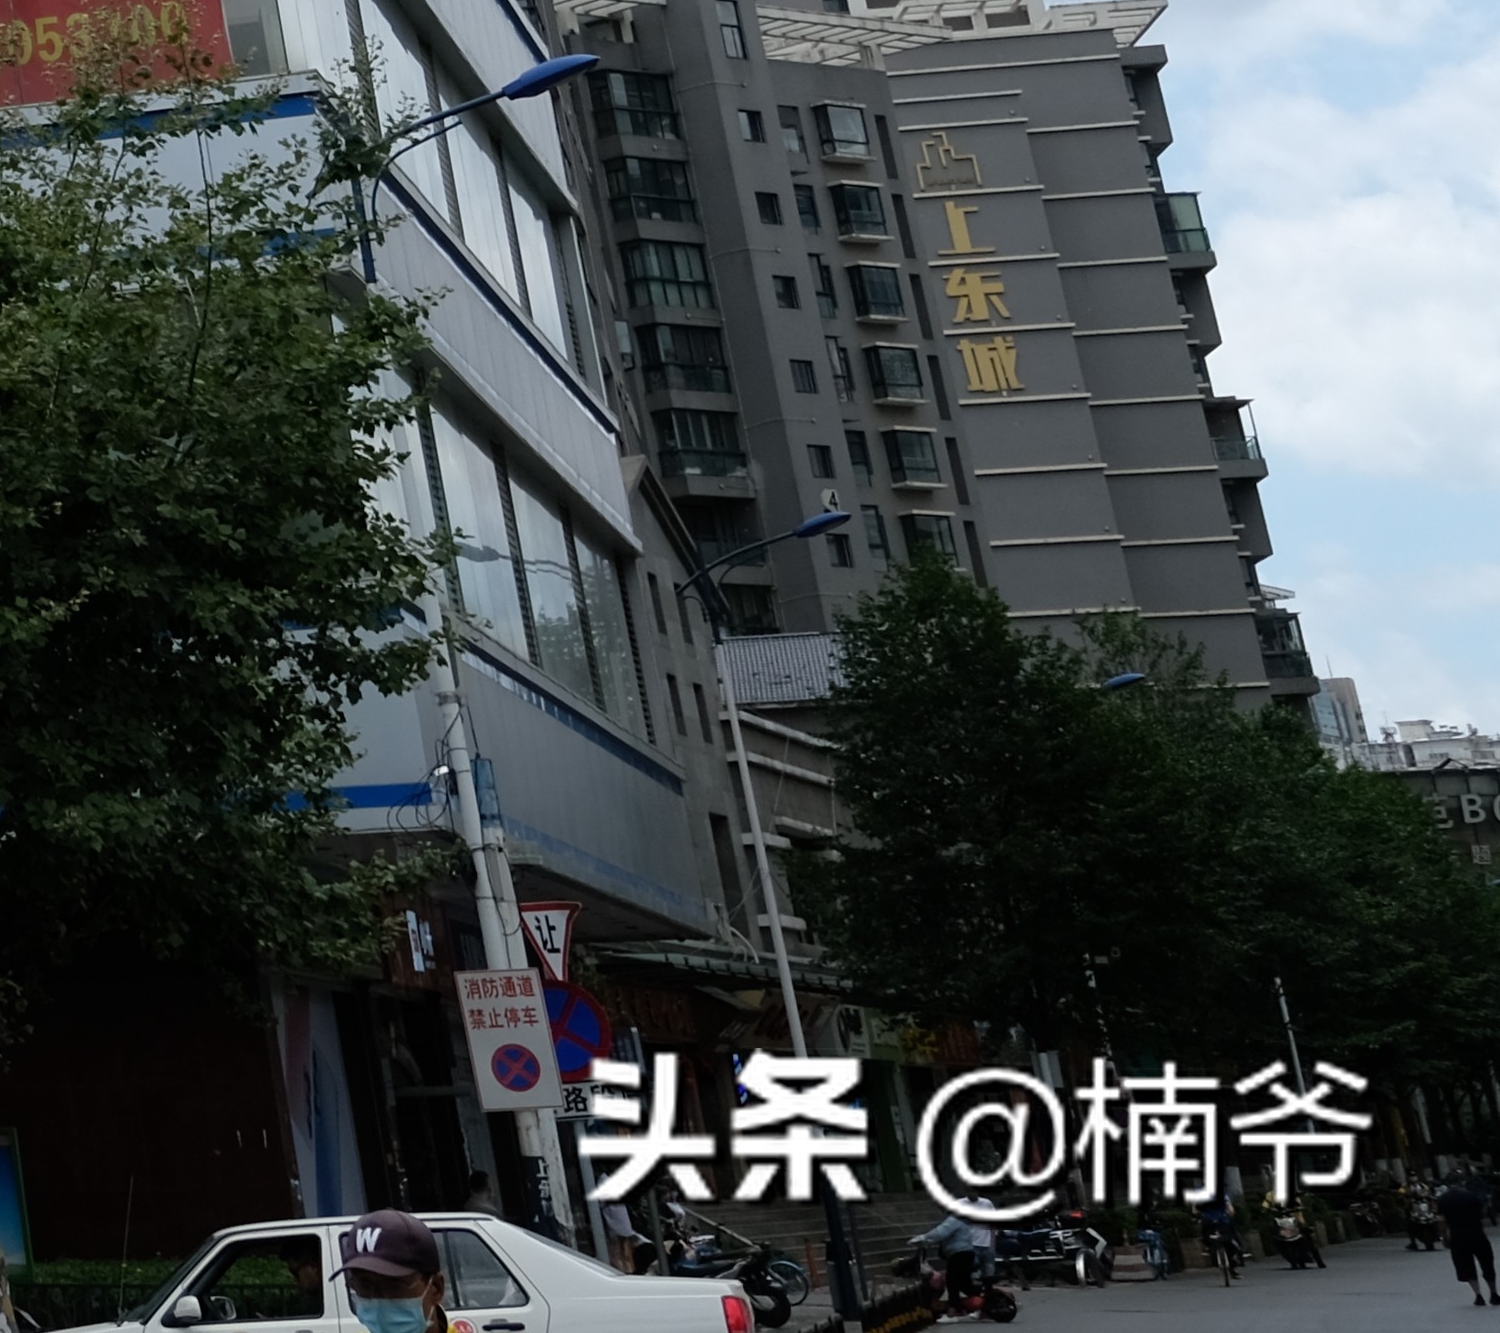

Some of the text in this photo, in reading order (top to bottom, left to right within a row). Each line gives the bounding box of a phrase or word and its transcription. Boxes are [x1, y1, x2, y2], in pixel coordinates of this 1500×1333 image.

[938, 201, 1026, 393] 上东城
[534, 913, 561, 954] 让
[463, 975, 536, 1000] 消防通道
[469, 1005, 539, 1030] 禁止停车
[355, 1226, 383, 1253] W
